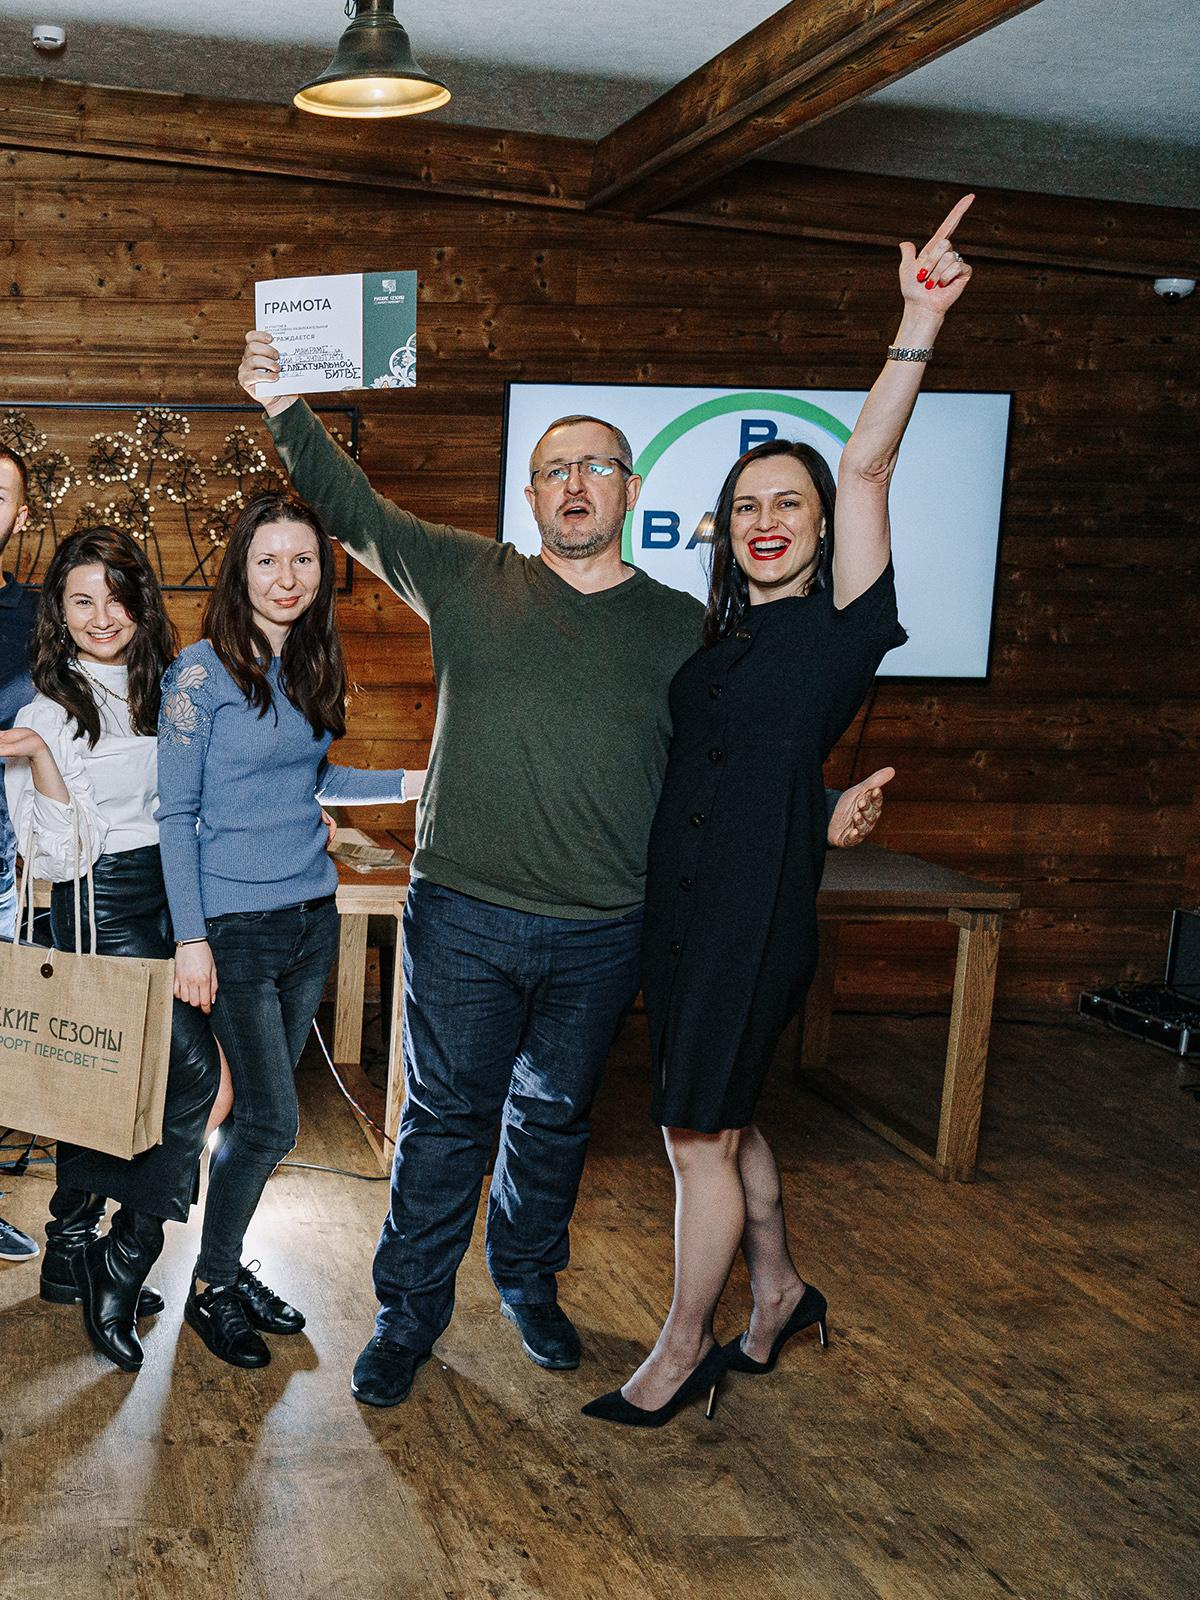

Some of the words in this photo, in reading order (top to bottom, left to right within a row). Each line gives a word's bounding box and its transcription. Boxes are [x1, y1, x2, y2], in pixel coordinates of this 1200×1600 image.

[264, 298, 332, 315] ГРАМОТА
[273, 334, 316, 342] ГРАЖДАЕТСЯ
[280, 359, 354, 373] ЕЛЛЕКТУАЛЬНОЙ
[324, 367, 361, 379] БИТВЕ
[49, 1016, 123, 1052] СЕЗОНЫ
[34, 1038, 99, 1069] ПЕРЕСВЕТ
